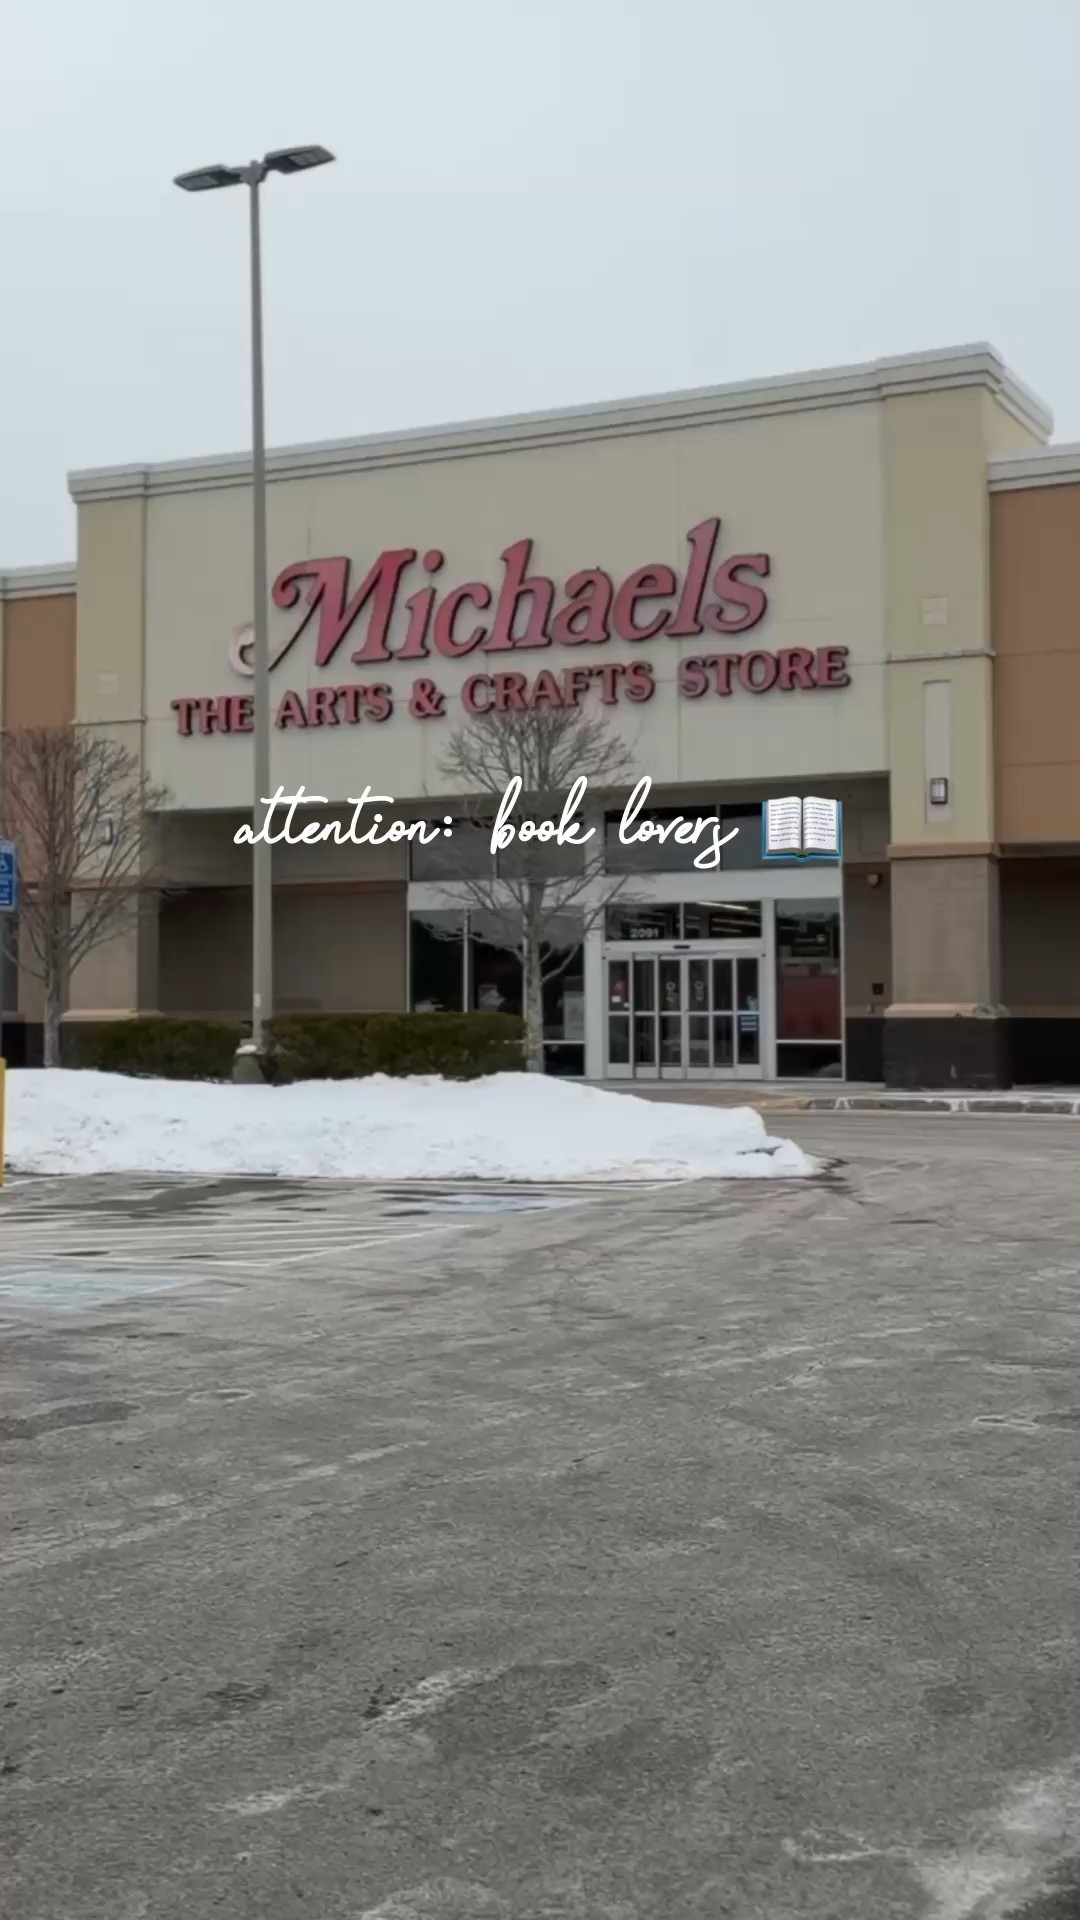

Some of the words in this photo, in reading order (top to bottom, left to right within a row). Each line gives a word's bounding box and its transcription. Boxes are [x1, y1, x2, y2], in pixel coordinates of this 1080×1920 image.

[229, 517, 771, 676] Michaels
[172, 695, 254, 736] THE
[275, 683, 392, 729] ARTS
[408, 678, 446, 719] &
[460, 660, 656, 715] CRAFTS
[678, 645, 851, 699] STORE
